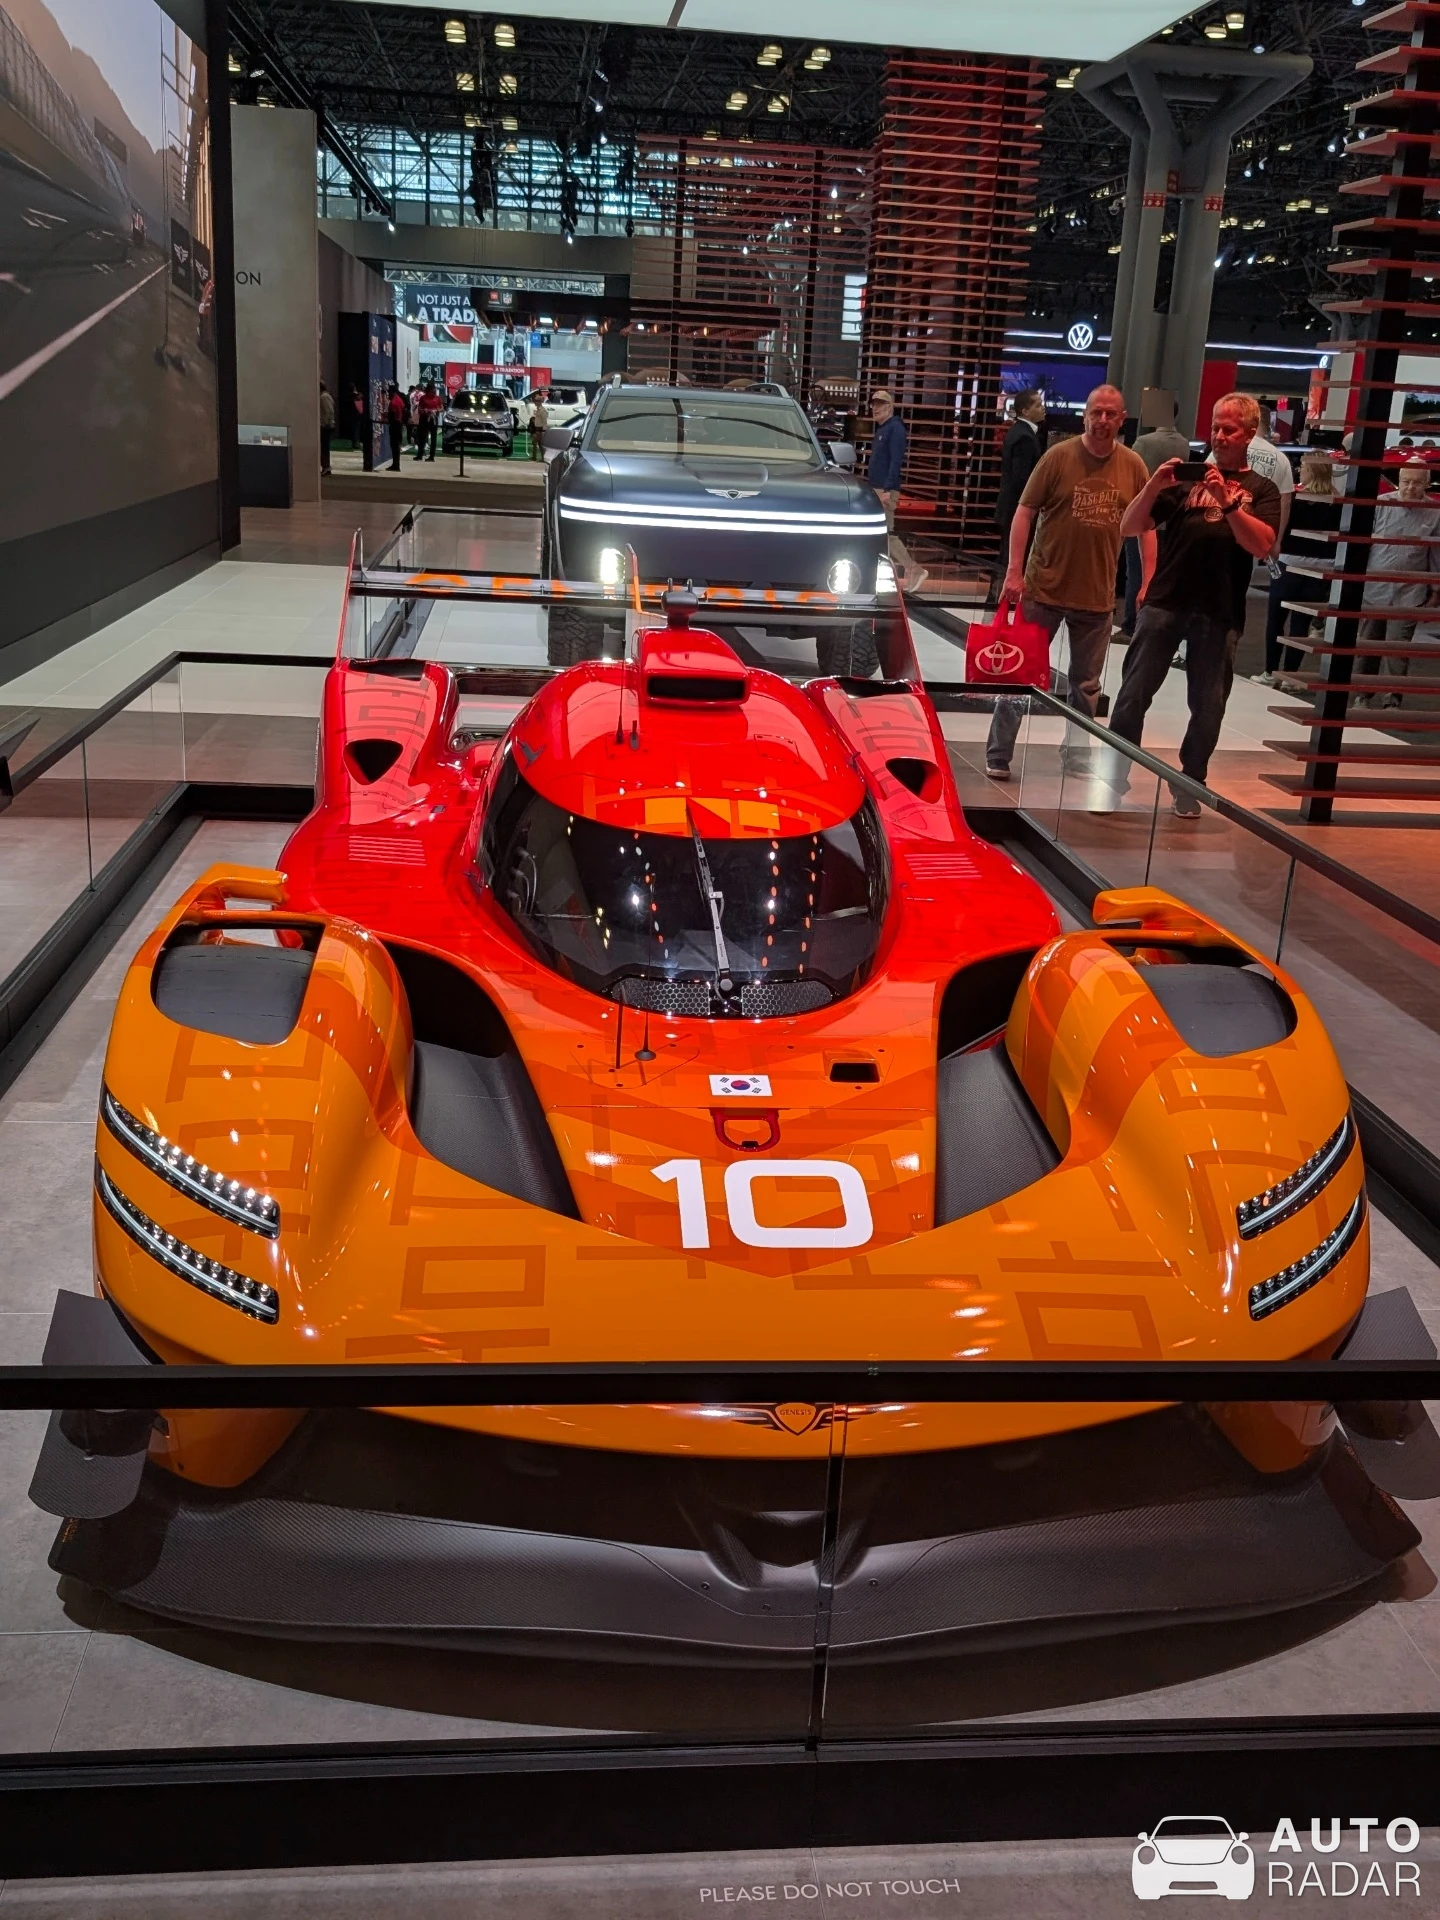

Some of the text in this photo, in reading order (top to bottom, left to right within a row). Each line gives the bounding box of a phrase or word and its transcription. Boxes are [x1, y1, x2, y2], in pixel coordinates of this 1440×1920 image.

[236, 271, 261, 285] ON
[417, 294, 471, 306] NOT JUST A
[417, 307, 429, 321] A
[419, 365, 443, 382] 41
[1246, 453, 1276, 466] SHVILLE
[1072, 489, 1120, 509] BASEBALL
[650, 1159, 874, 1248] 10
[700, 1878, 961, 1903] PLEASE DO NOT TOUCH
